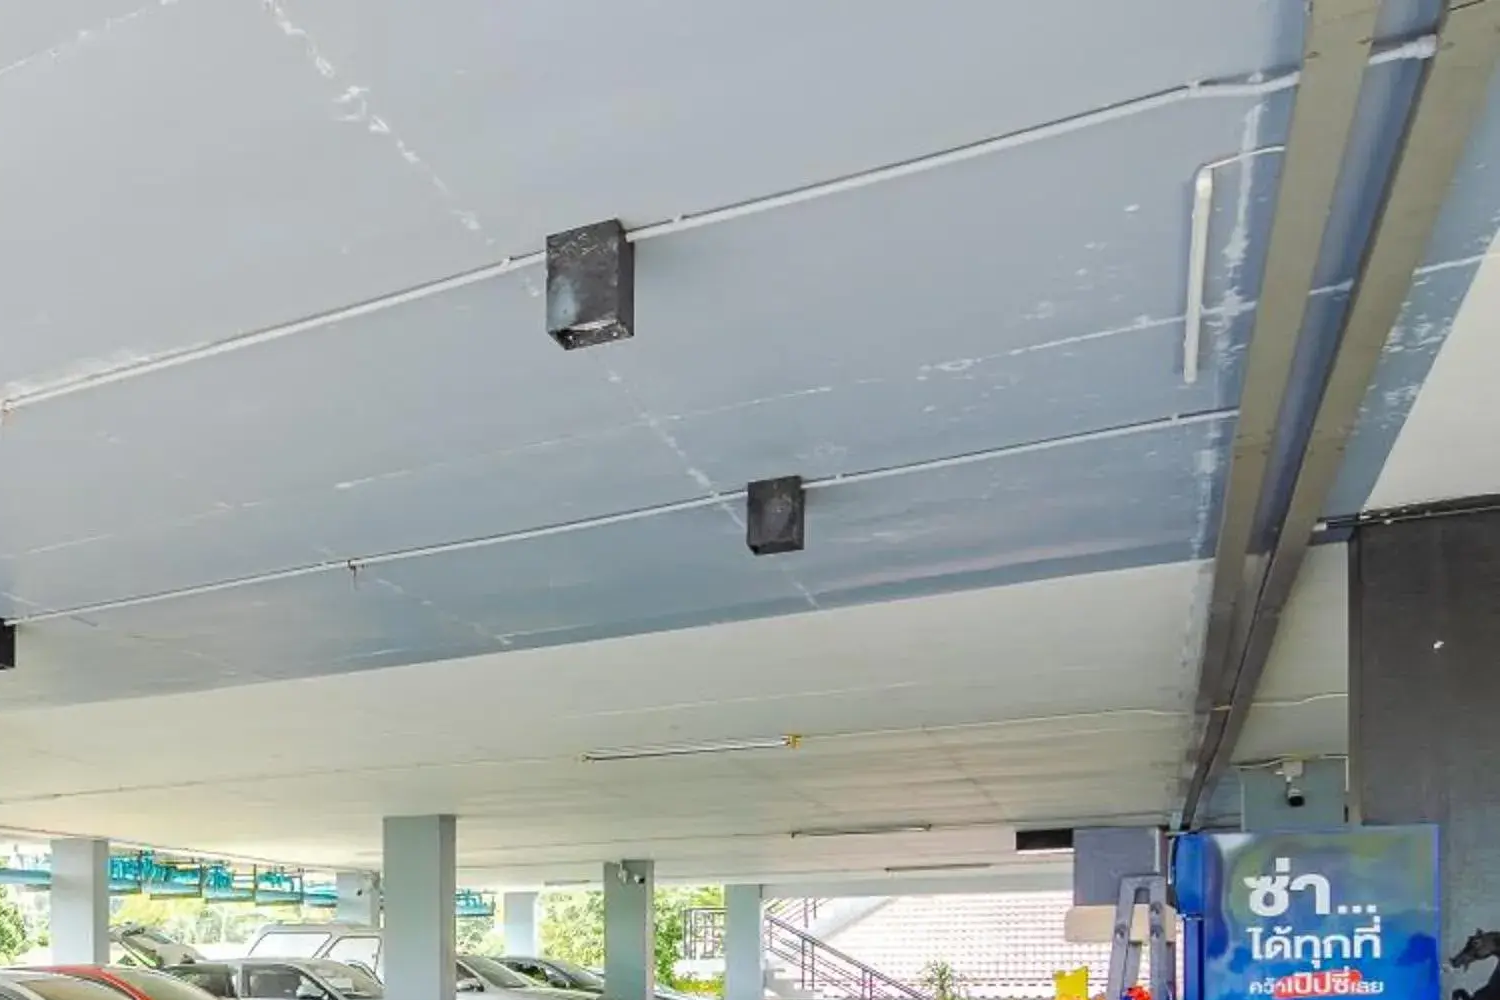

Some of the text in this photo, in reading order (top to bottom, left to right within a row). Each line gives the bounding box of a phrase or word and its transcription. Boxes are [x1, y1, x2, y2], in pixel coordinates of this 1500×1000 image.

[1243, 857, 1377, 916] ซ่า...
[1246, 915, 1381, 969] ได้ทุกที่
